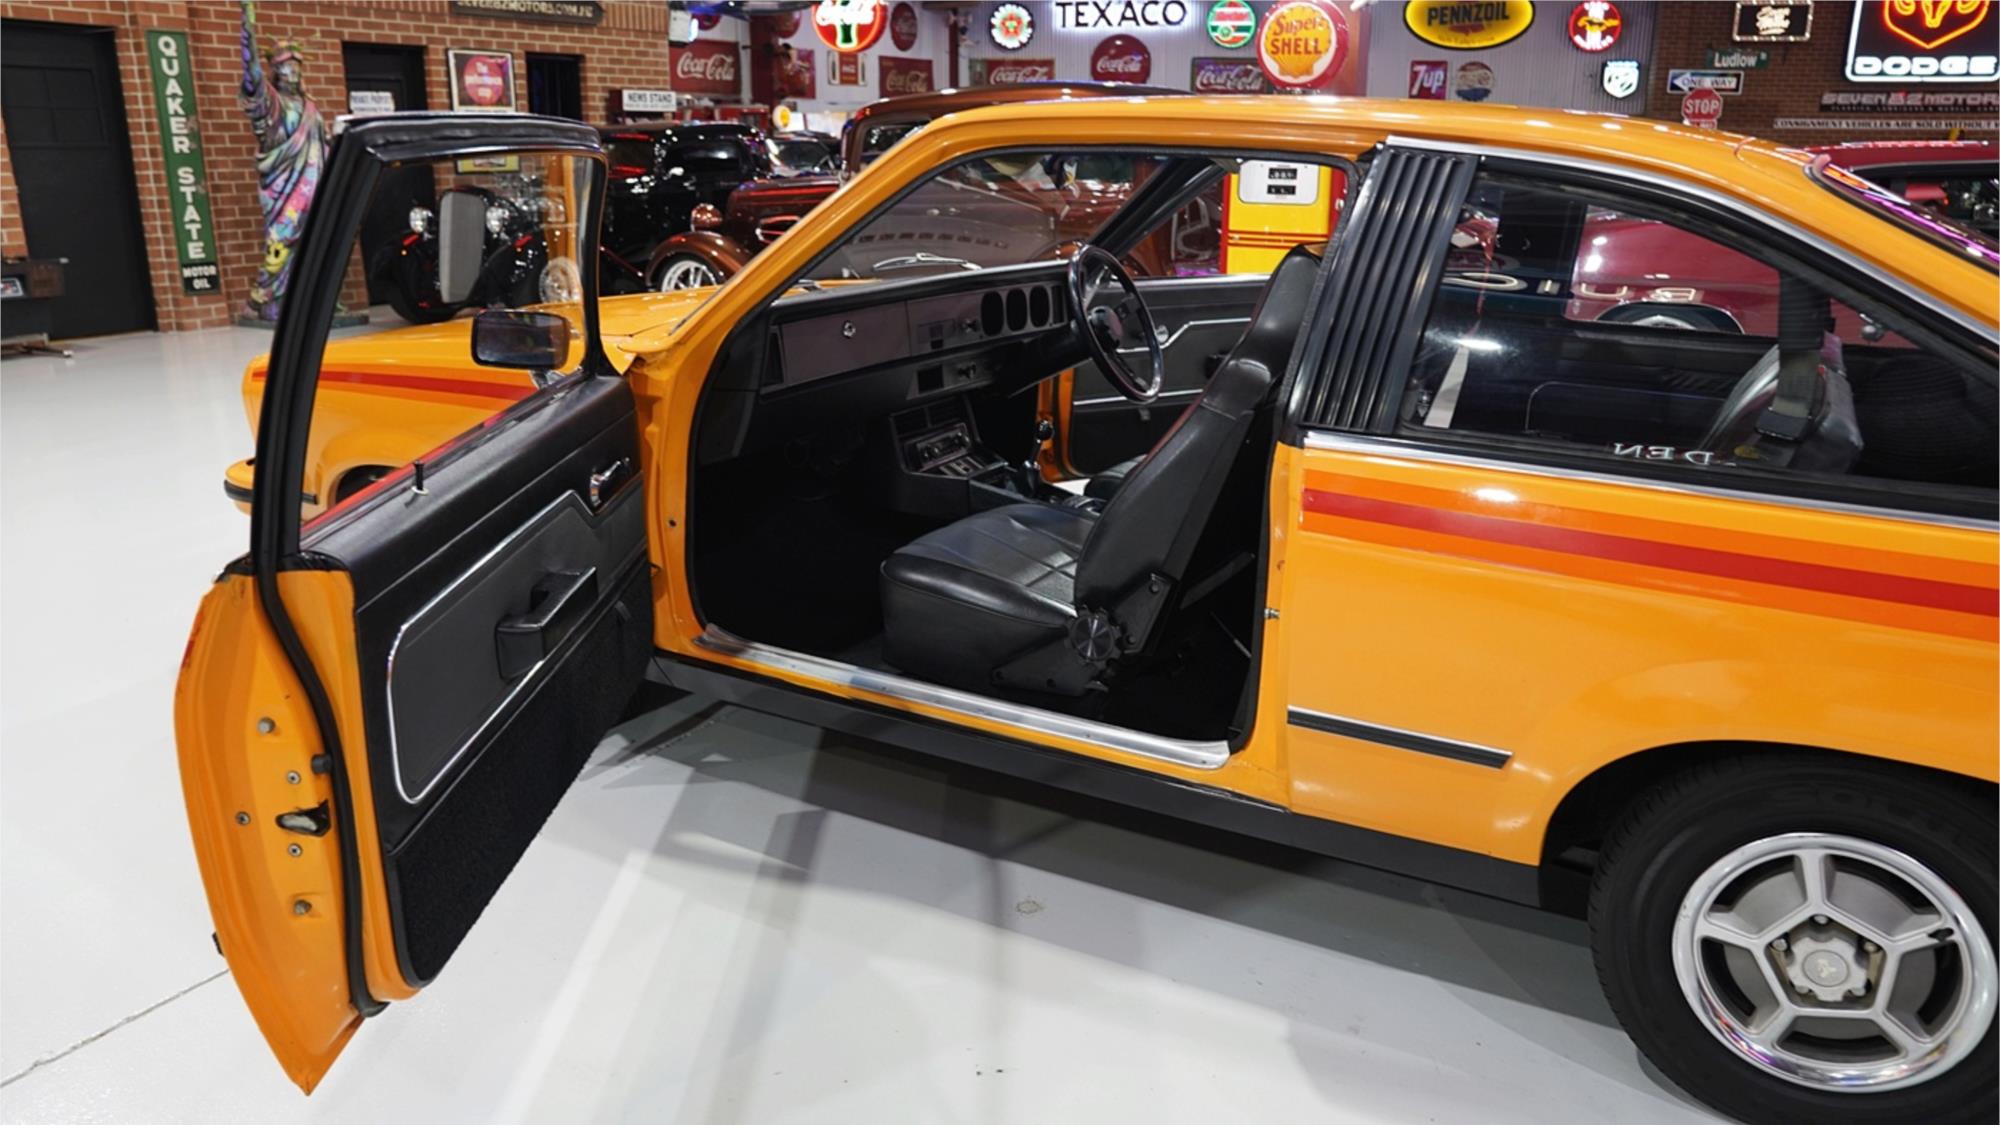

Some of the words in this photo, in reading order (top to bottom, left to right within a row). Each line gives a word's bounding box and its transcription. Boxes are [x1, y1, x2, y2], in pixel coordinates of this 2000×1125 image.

[1055, 1, 1188, 28] TEXACO
[1427, 1, 1510, 26] PENNZOIL
[1270, 39, 1322, 55] SHELL
[1714, 52, 1758, 67] Ludlow
[1854, 56, 1998, 75] DODGE
[1411, 64, 1445, 96] 7up
[1682, 77, 1705, 87] ONE
[1710, 77, 1734, 87] WAY
[627, 92, 648, 103] NEWS
[649, 93, 673, 103] STAND
[1924, 93, 1999, 106] MOTOR
[1684, 98, 1721, 114] STOP
[1895, 120, 1912, 129] ARE
[1916, 120, 1942, 129] SOLD
[157, 35, 191, 154] QUAKER
[177, 167, 206, 259] STATE
[182, 265, 217, 278] MOTOR
[193, 278, 211, 290] OIL
